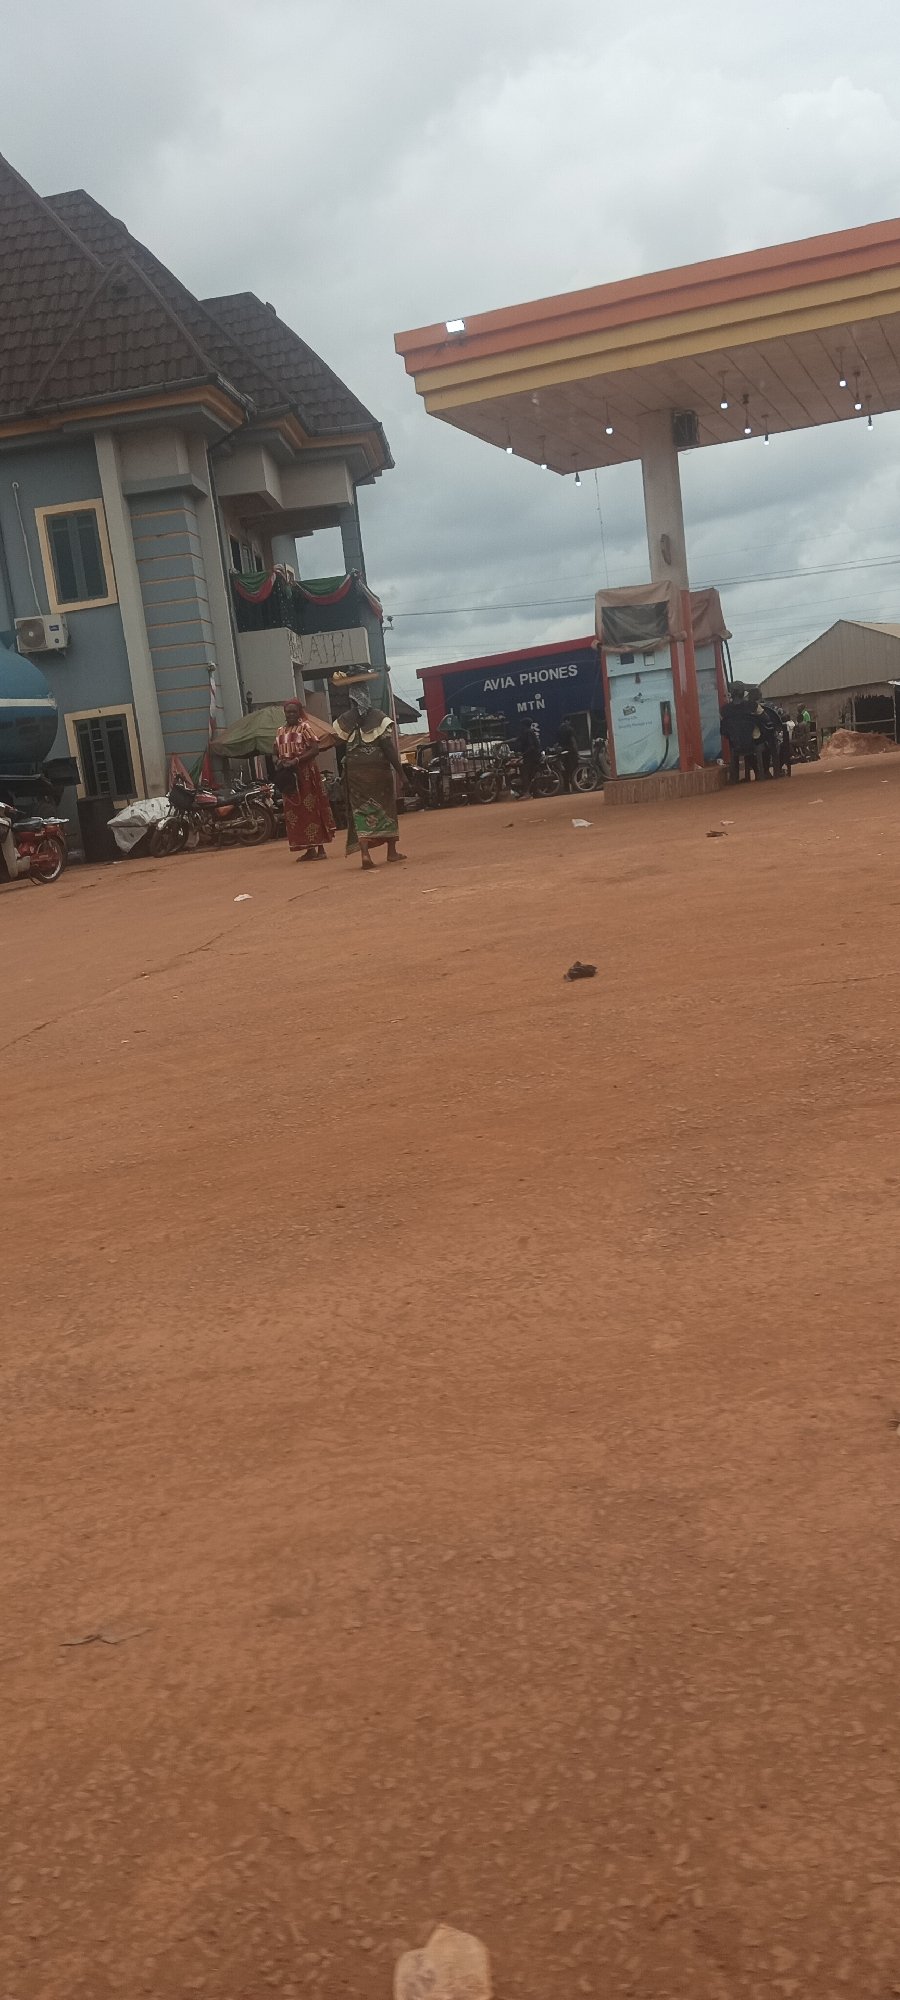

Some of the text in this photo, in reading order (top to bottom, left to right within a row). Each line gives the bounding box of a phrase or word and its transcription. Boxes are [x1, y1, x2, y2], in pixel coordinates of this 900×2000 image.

[484, 664, 578, 692] AVIA PHONES
[517, 699, 546, 713] MTN
